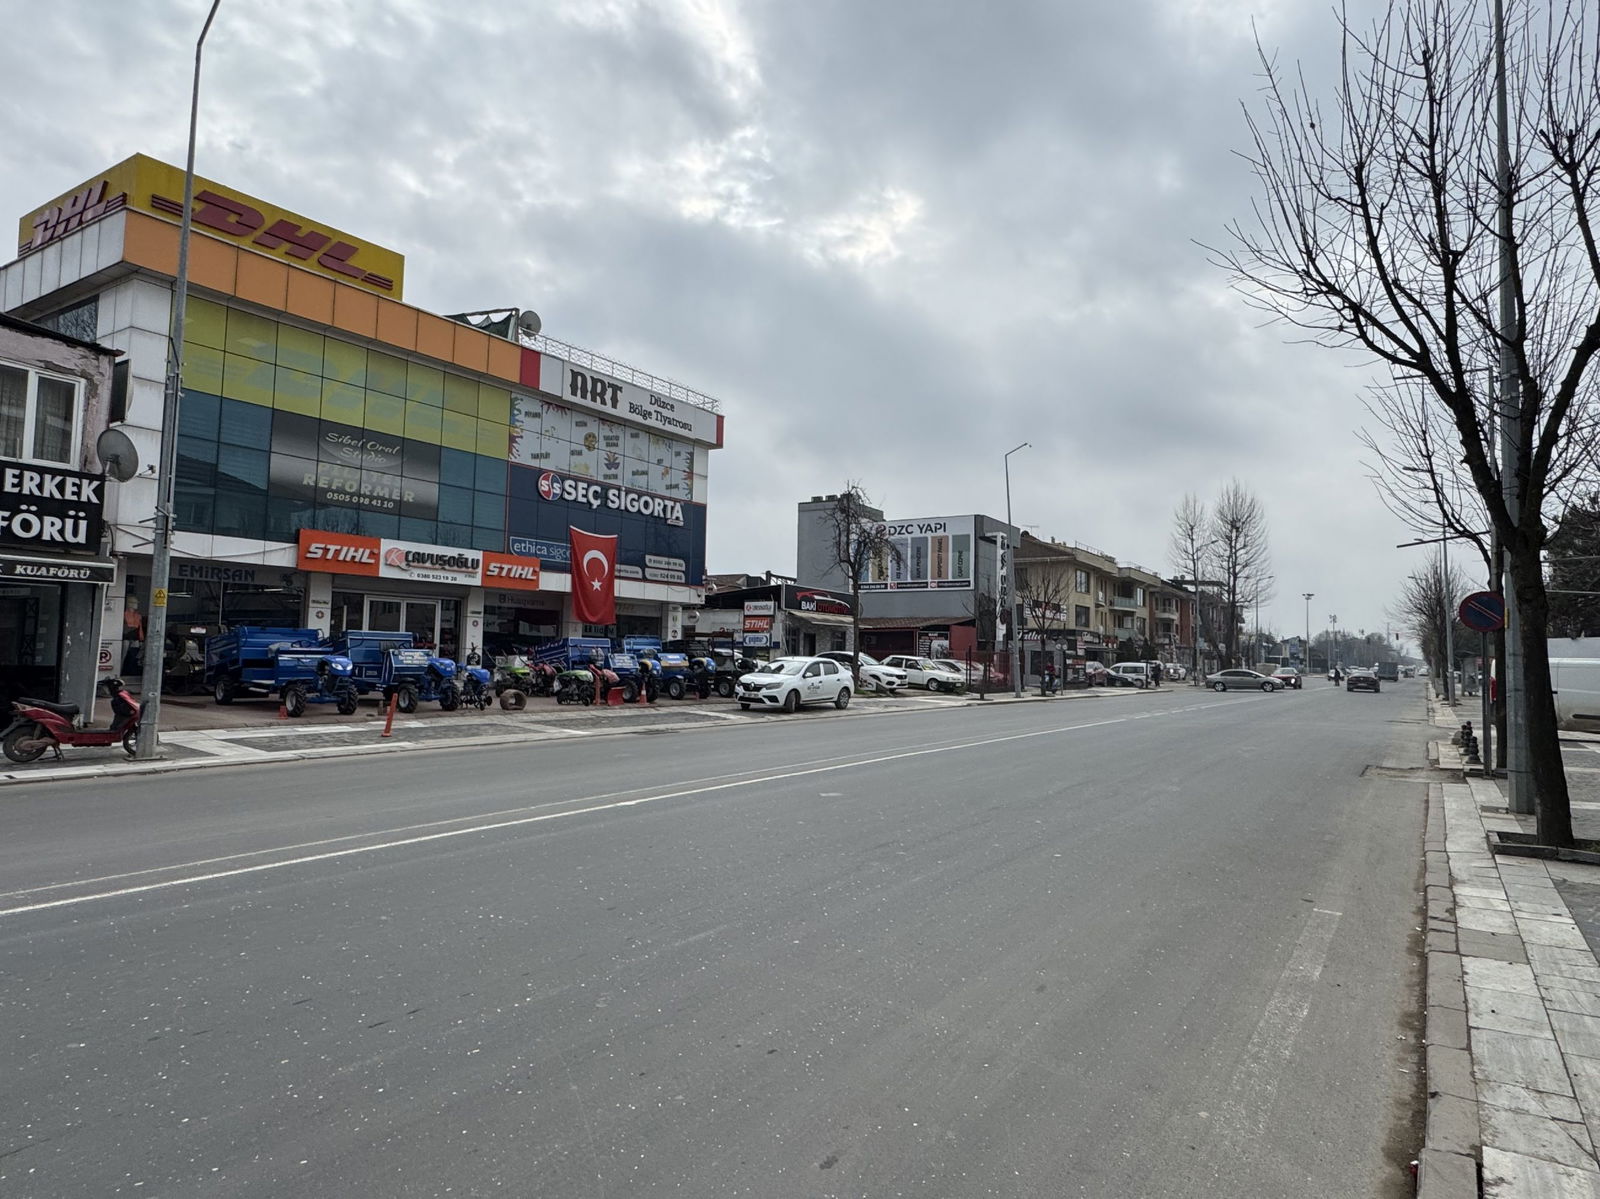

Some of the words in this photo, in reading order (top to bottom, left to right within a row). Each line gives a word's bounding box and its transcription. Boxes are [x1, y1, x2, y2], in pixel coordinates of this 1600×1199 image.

[31, 181, 109, 249] DHL
[190, 190, 367, 279] DHL
[569, 368, 623, 410] NRT
[649, 393, 675, 412] Düzce
[628, 402, 653, 421] Bölge
[654, 410, 693, 432] Tiyatrosu
[325, 432, 365, 449] Sibel
[366, 441, 400, 455] Oral
[340, 447, 387, 464] Studio
[3, 467, 101, 504] ERKEK
[303, 473, 416, 502] REFORMER
[326, 491, 351, 502] 0505
[562, 480, 601, 509] SEÇ
[607, 487, 684, 521] SİGORTA
[0, 504, 88, 544] FÖRÜ
[888, 524, 914, 536] DZC
[917, 522, 947, 534] YAPI
[305, 543, 376, 564] STIHL
[513, 540, 548, 556] ethica
[404, 550, 480, 570] ÇAVUŞOĞLU
[14, 563, 90, 579] KUAFÖRÜ
[177, 563, 256, 582] EMİRSAN
[486, 562, 538, 580] STIHL
[801, 599, 816, 611] BAKİ
[744, 619, 769, 629] STIHL
